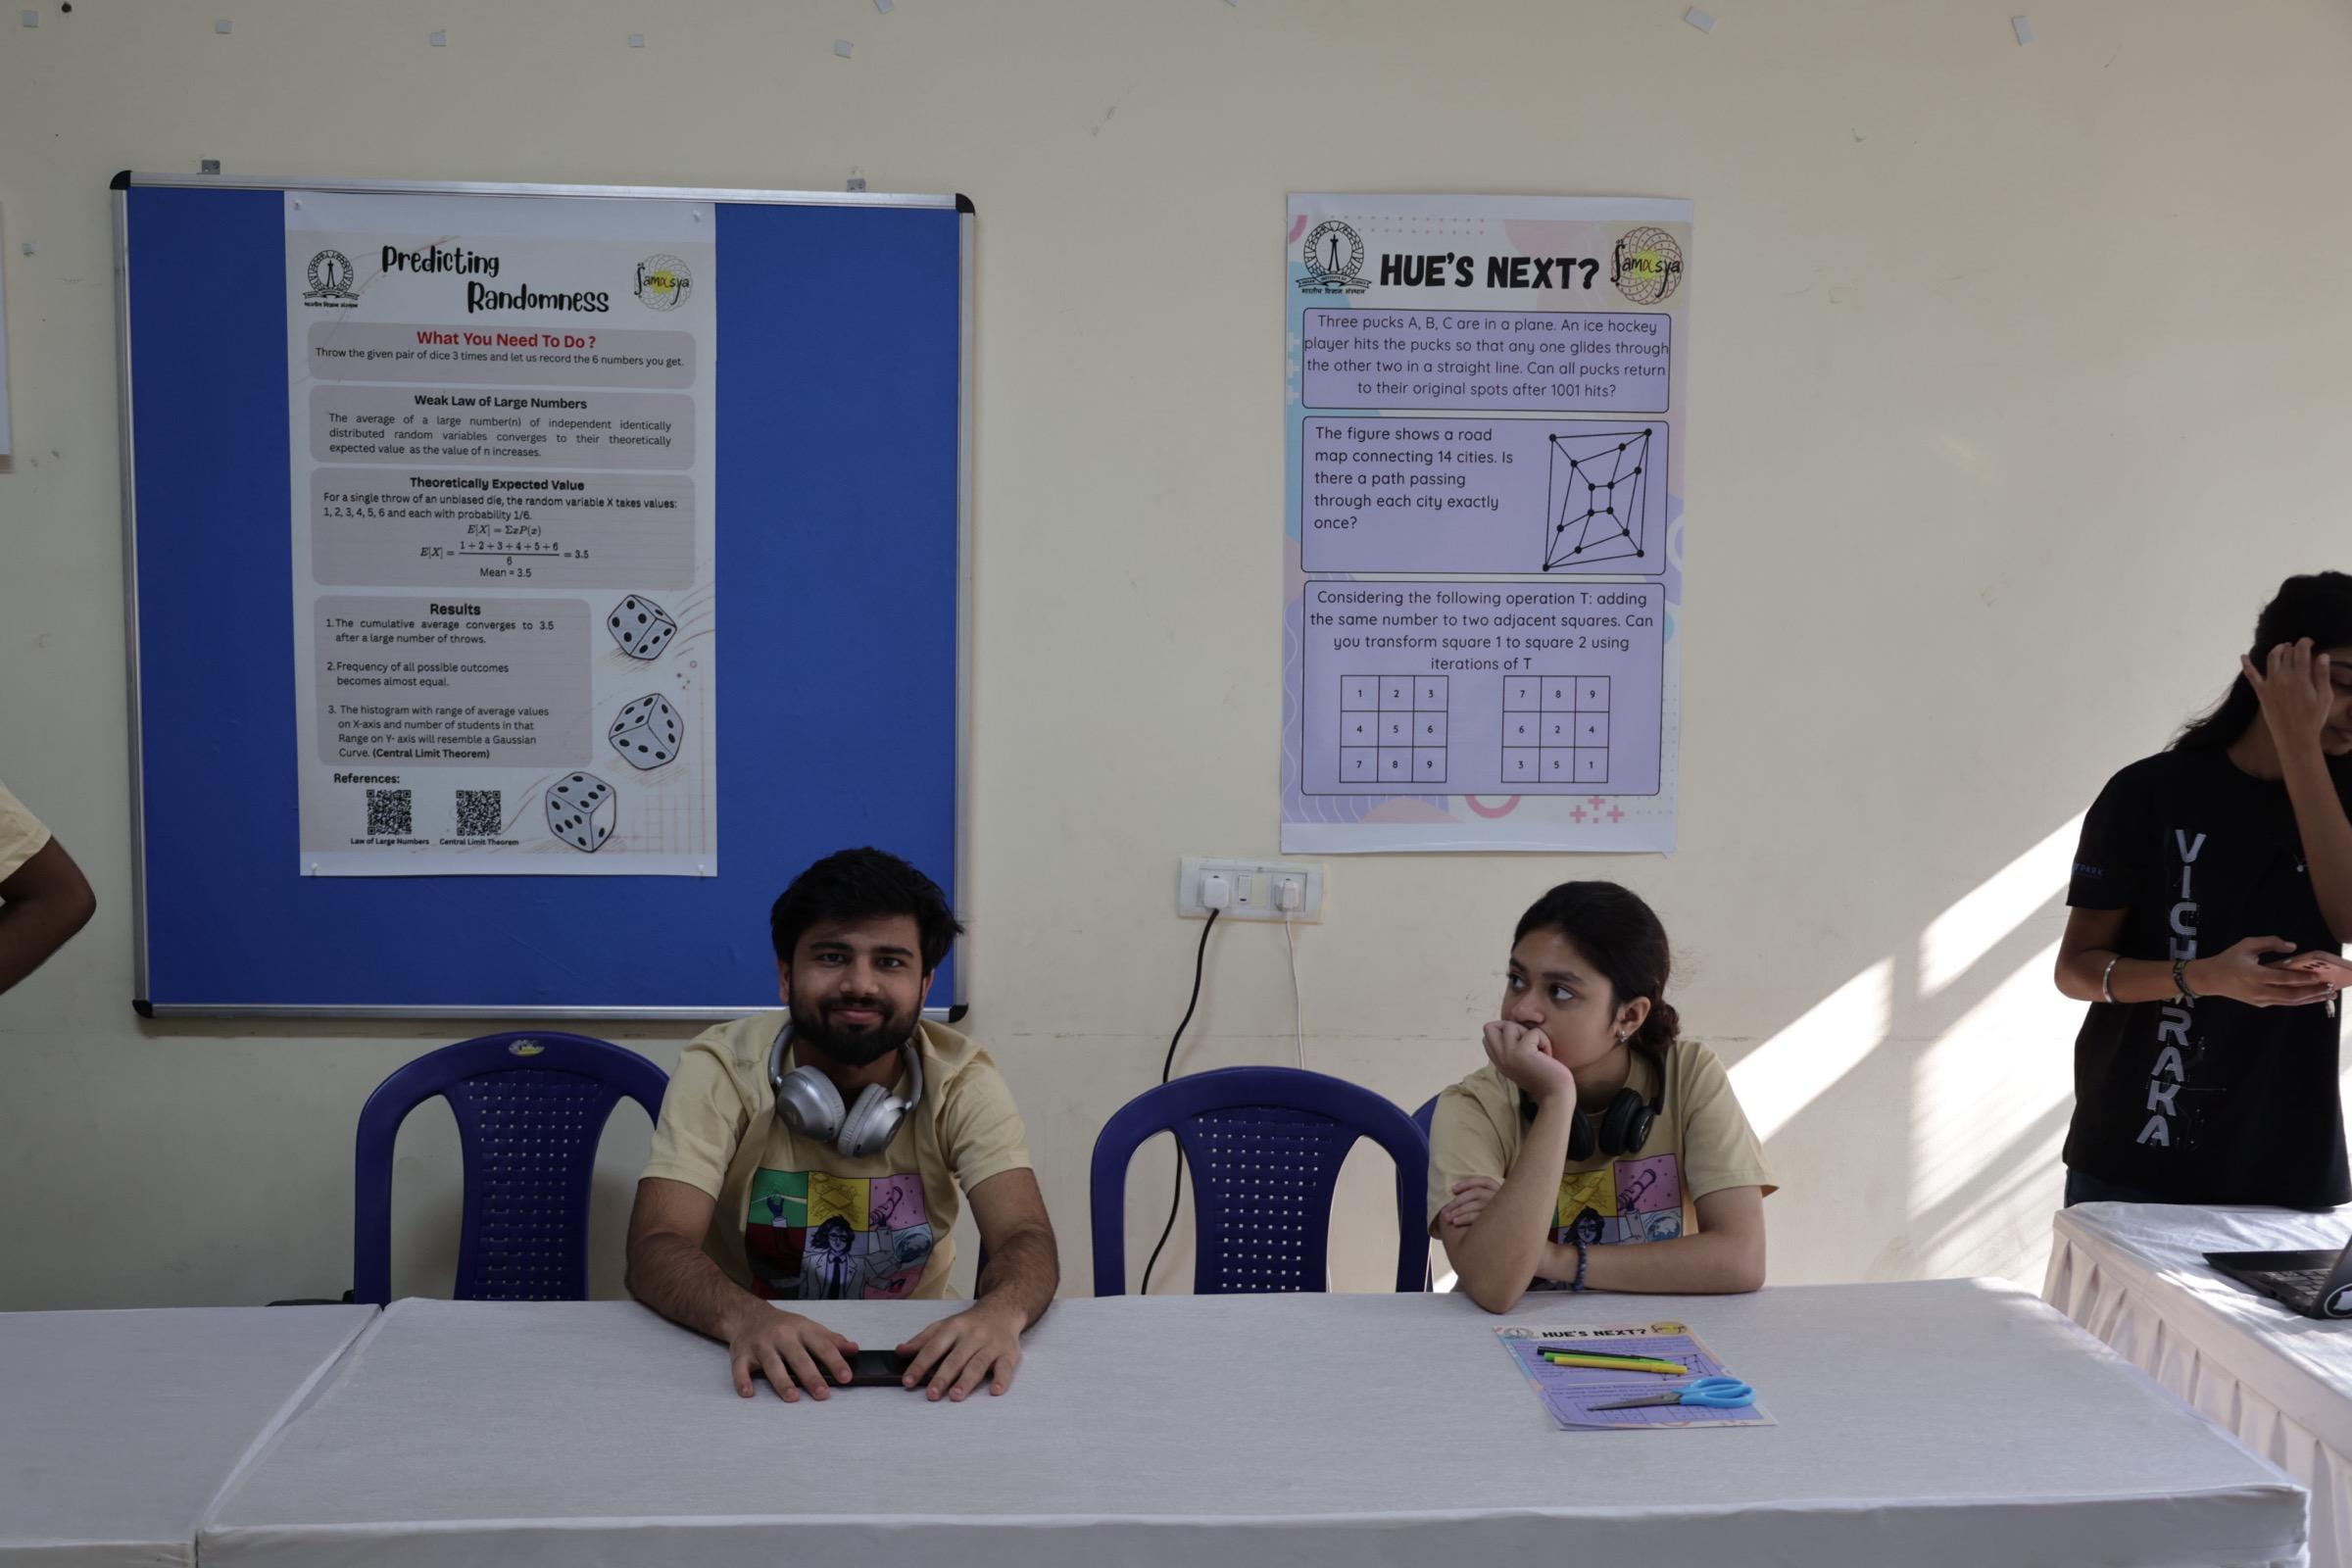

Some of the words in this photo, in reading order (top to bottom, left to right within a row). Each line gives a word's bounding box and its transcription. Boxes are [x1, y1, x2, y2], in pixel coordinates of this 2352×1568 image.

[381, 245, 500, 277] Predicting
[1487, 256, 1599, 289] NEXT?
[467, 280, 610, 314] Randomness
[1316, 314, 1358, 327] Three
[1362, 315, 1403, 329] pucks
[1407, 316, 1421, 329] A,
[1425, 316, 1438, 330] B,
[1442, 316, 1452, 329] C
[1456, 319, 1480, 329] are
[1484, 318, 1495, 329] in
[1500, 319, 1509, 330] a
[1514, 318, 1556, 333] plane.
[1560, 318, 1579, 331] An
[1584, 319, 1603, 331] ice
[1607, 318, 1656, 336] hockey
[416, 330, 459, 345] What
[463, 331, 492, 345] You
[496, 332, 538, 347] Need
[541, 334, 560, 347] To
[564, 334, 585, 348] Do
[588, 335, 596, 348] ?
[1304, 337, 1349, 352] player
[1353, 336, 1379, 350] hits
[1383, 336, 1405, 350] the
[1410, 337, 1450, 353] pucks
[1455, 341, 1472, 351] so
[1476, 338, 1503, 352] that
[1508, 341, 1535, 355] any
[1539, 342, 1566, 353] one
[1569, 339, 1611, 356] glides
[1615, 341, 1669, 358] through
[315, 347, 346, 357] Throw
[348, 348, 365, 358] the
[366, 348, 393, 360] given
[395, 349, 415, 361] pair
[416, 349, 427, 359] of
[428, 350, 450, 360] dice
[452, 351, 459, 360] 3
[460, 351, 487, 361] times
[489, 352, 508, 361] and
[510, 352, 523, 362] let
[539, 354, 571, 363] record
[572, 354, 590, 364] the
[591, 354, 599, 364] 6
[600, 355, 644, 365] numbers
[645, 357, 663, 368] you
[665, 357, 684, 368] get.
[1306, 358, 1329, 371] the
[1333, 358, 1372, 371] other
[1376, 360, 1402, 372] two
[1407, 360, 1419, 371] in
[1423, 363, 1432, 372] a
[1437, 360, 1491, 376] straight
[1495, 360, 1522, 373] line.
[1527, 361, 1554, 374] Can
[1558, 361, 1575, 374] all
[1580, 362, 1619, 376] pucks
[1624, 365, 1666, 376] return
[1356, 381, 1371, 394] to
[1376, 380, 1408, 394] their
[1412, 381, 1465, 397] original
[1470, 383, 1508, 397] spots
[1512, 382, 1546, 396] after
[1550, 383, 1579, 396] 1001
[1585, 383, 1616, 397] hits?
[414, 394, 449, 406] Weak
[451, 395, 476, 406] Law
[478, 395, 492, 406] of
[494, 396, 527, 410] Large
[530, 397, 587, 409] Numbers
[328, 413, 348, 422] The
[354, 415, 395, 426] average
[403, 414, 415, 423] of
[436, 415, 462, 427] large
[469, 416, 521, 427] number(n)
[529, 416, 541, 427] of
[548, 417, 612, 429] independent
[619, 419, 671, 432] identically
[1314, 425, 1342, 439] The
[1347, 425, 1390, 442] figure
[1395, 426, 1440, 440] shows
[1444, 430, 1453, 440] a
[1458, 427, 1492, 441] road
[1314, 451, 1348, 465] map
[1351, 450, 1433, 466] connecting
[1438, 450, 1451, 463] 14
[1456, 450, 1496, 463] cities.
[1501, 451, 1513, 464] Is
[410, 476, 489, 491] Theoretically
[491, 478, 548, 491] Expected
[551, 479, 584, 490] Value
[1314, 470, 1352, 484] there
[1357, 473, 1366, 484] a
[1371, 471, 1404, 487] path
[1409, 472, 1465, 488] passing
[1313, 493, 1371, 510] through
[1376, 494, 1411, 507] each
[1416, 494, 1442, 510] city
[1446, 494, 1498, 511] exactly
[1313, 515, 1357, 528] once?
[1317, 590, 1403, 607] Considering
[1407, 590, 1431, 604] the
[1436, 590, 1500, 607] following
[1505, 592, 1574, 607] operation
[1579, 592, 1592, 604] T:
[1596, 591, 1646, 608] adding
[429, 603, 481, 615] Results
[1309, 612, 1333, 625] the
[1338, 615, 1377, 625] same
[1382, 612, 1438, 625] number
[1442, 613, 1457, 626] to
[1462, 614, 1489, 626] two
[1494, 612, 1556, 629] adjacent
[1560, 616, 1620, 629] squares.
[1625, 613, 1653, 626] Can
[1333, 637, 1360, 651] you
[1364, 634, 1437, 648] transform
[1442, 637, 1491, 651] square
[1495, 635, 1500, 648] 1
[1505, 636, 1521, 648] to
[1525, 638, 1573, 651] square
[1578, 635, 1586, 648] 2
[1592, 636, 1629, 652] using
[336, 661, 389, 673] Frequency
[390, 661, 402, 671] of
[402, 662, 415, 671] all
[416, 662, 458, 673] possible
[460, 663, 509, 672] outcomes
[1431, 658, 1498, 670] iterations
[1503, 657, 1519, 670] of
[1523, 657, 1532, 669] T
[338, 747, 369, 757] Curve.
[371, 748, 413, 758] (Central
[415, 748, 440, 758] Limit
[441, 749, 490, 759] Theorem)
[333, 772, 400, 783] References:
[2136, 829, 2207, 1147] VICHRAKA
